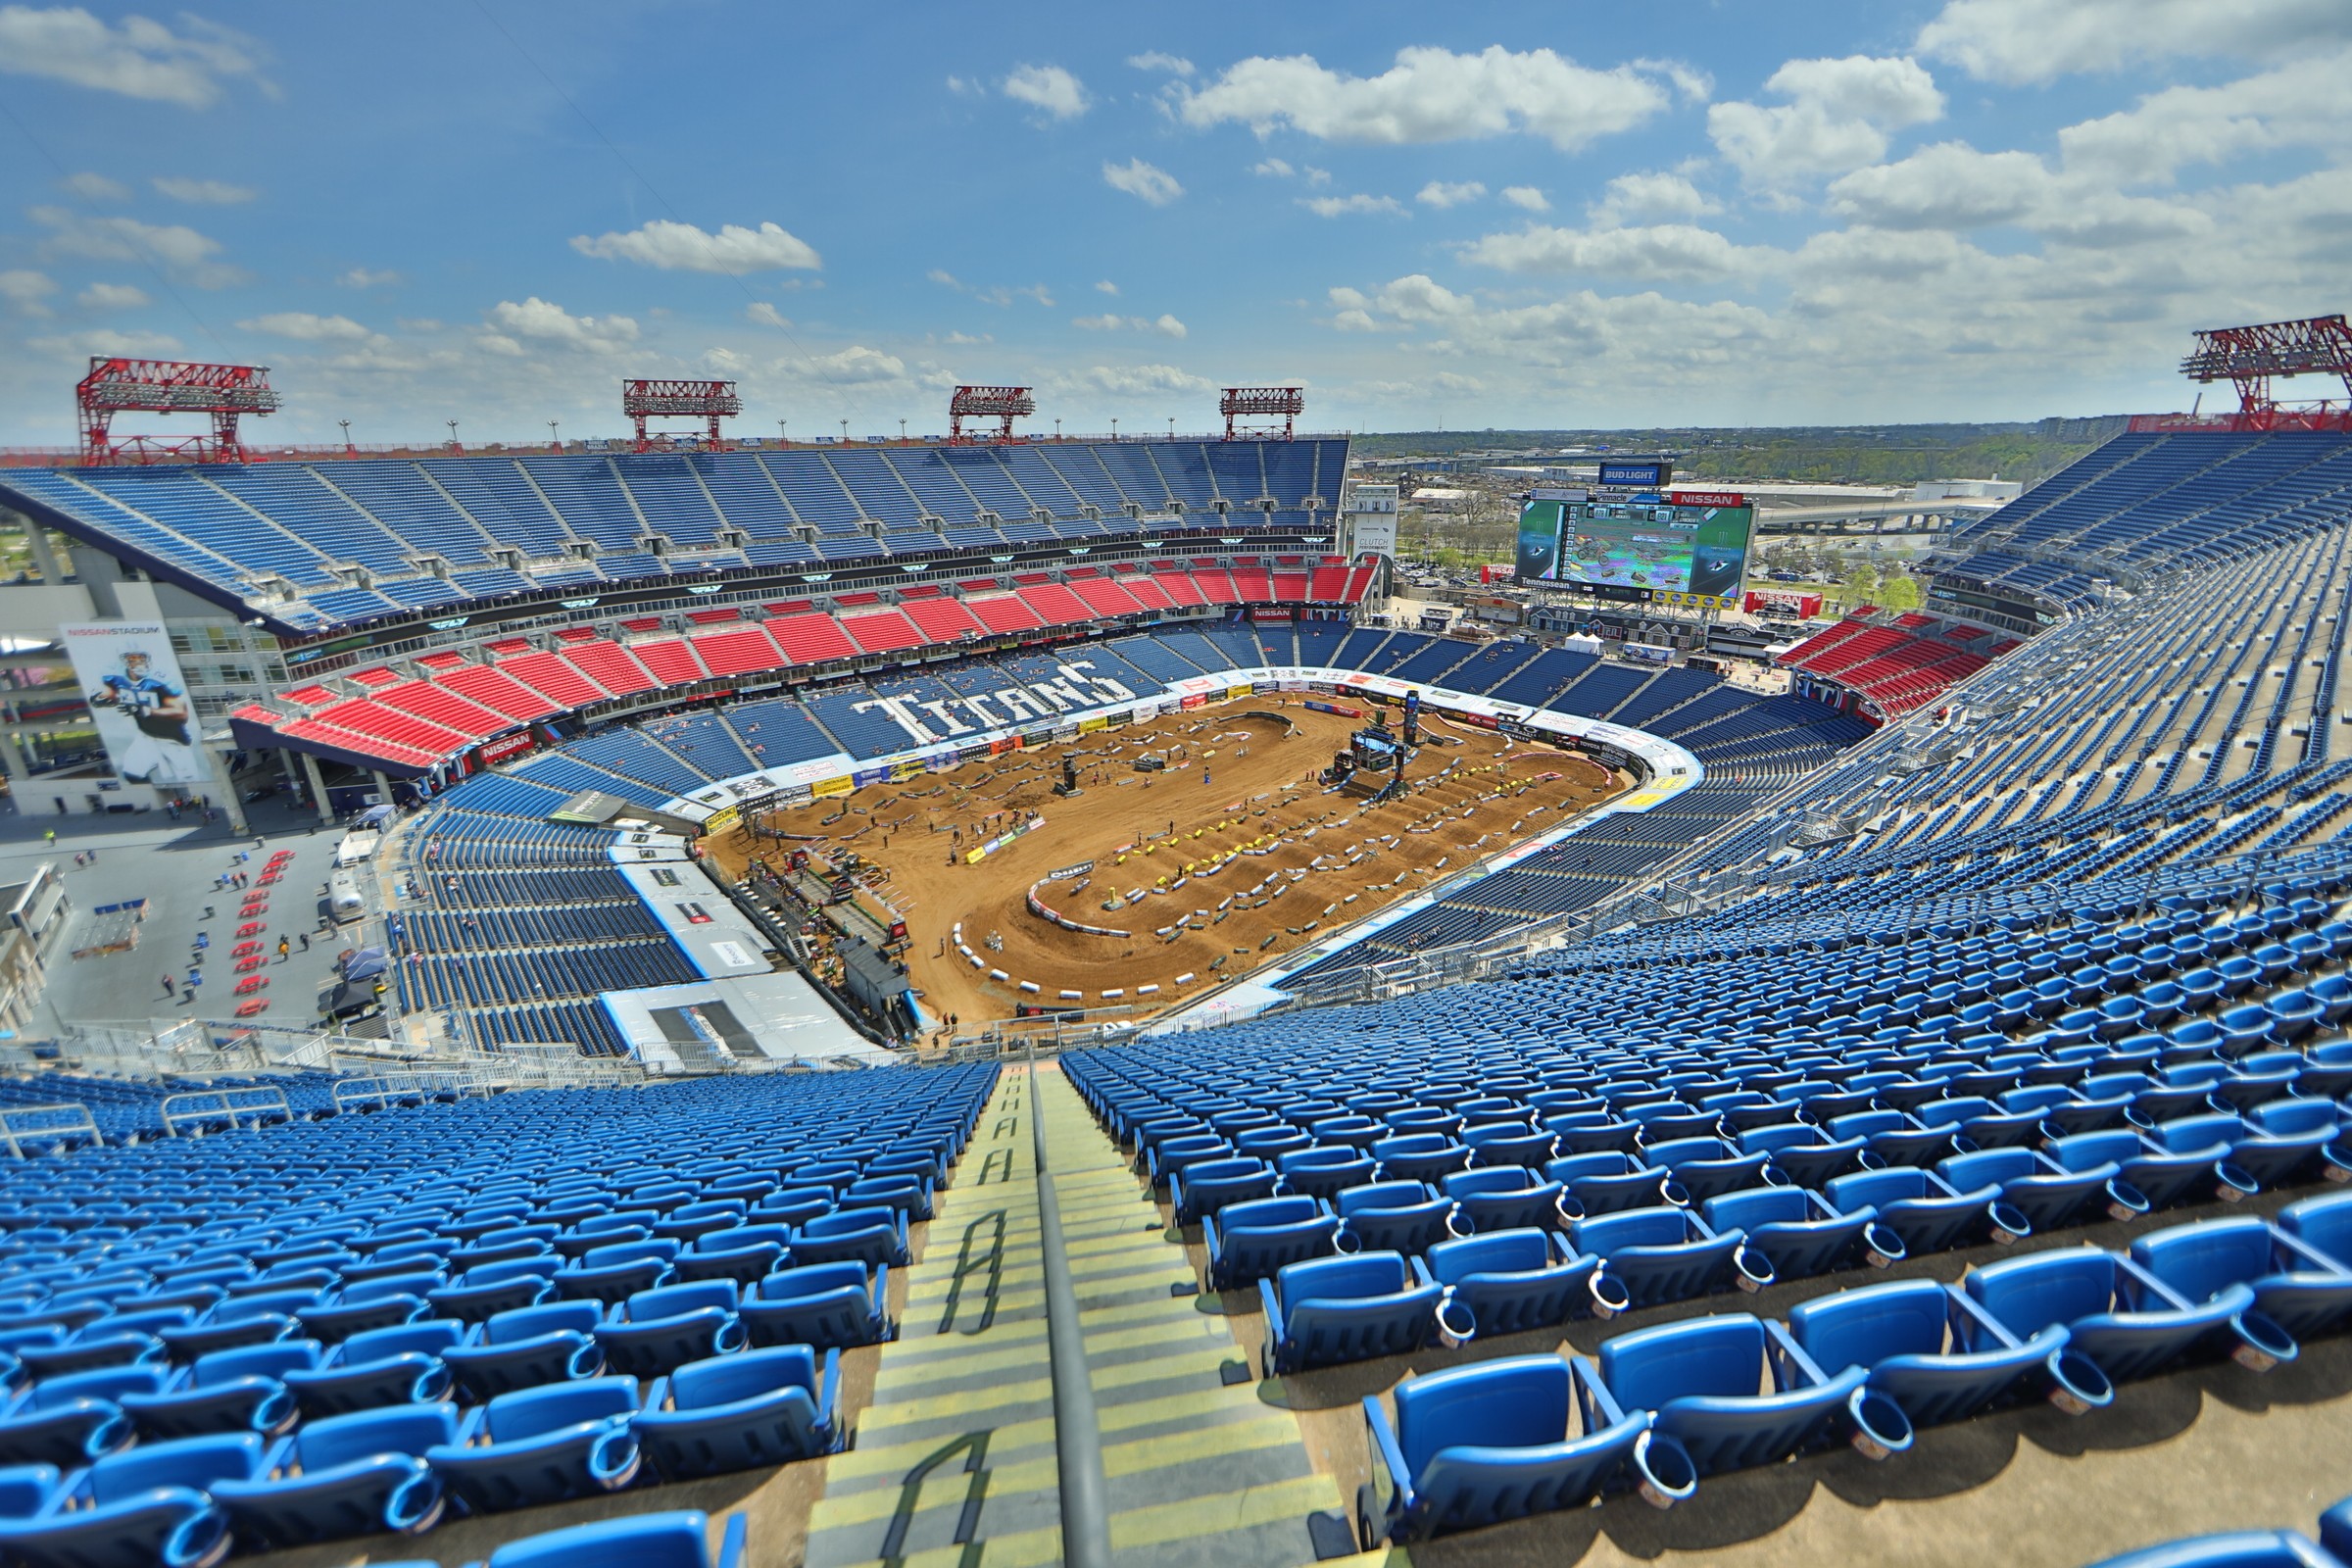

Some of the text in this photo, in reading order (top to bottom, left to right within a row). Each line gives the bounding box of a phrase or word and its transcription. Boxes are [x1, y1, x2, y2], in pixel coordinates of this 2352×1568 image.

[1605, 470, 1655, 480] BUD LIGHT
[1598, 493, 1627, 502] Pinnacle
[1681, 494, 1733, 505] NISSAN
[1754, 592, 1802, 605] NISSAN
[849, 661, 1135, 746] TITANS
[483, 733, 529, 758] NISSAN
[968, 745, 990, 754] OAKLEY
[1365, 737, 1389, 751] FINISH
[708, 807, 736, 824] SUZUKI
